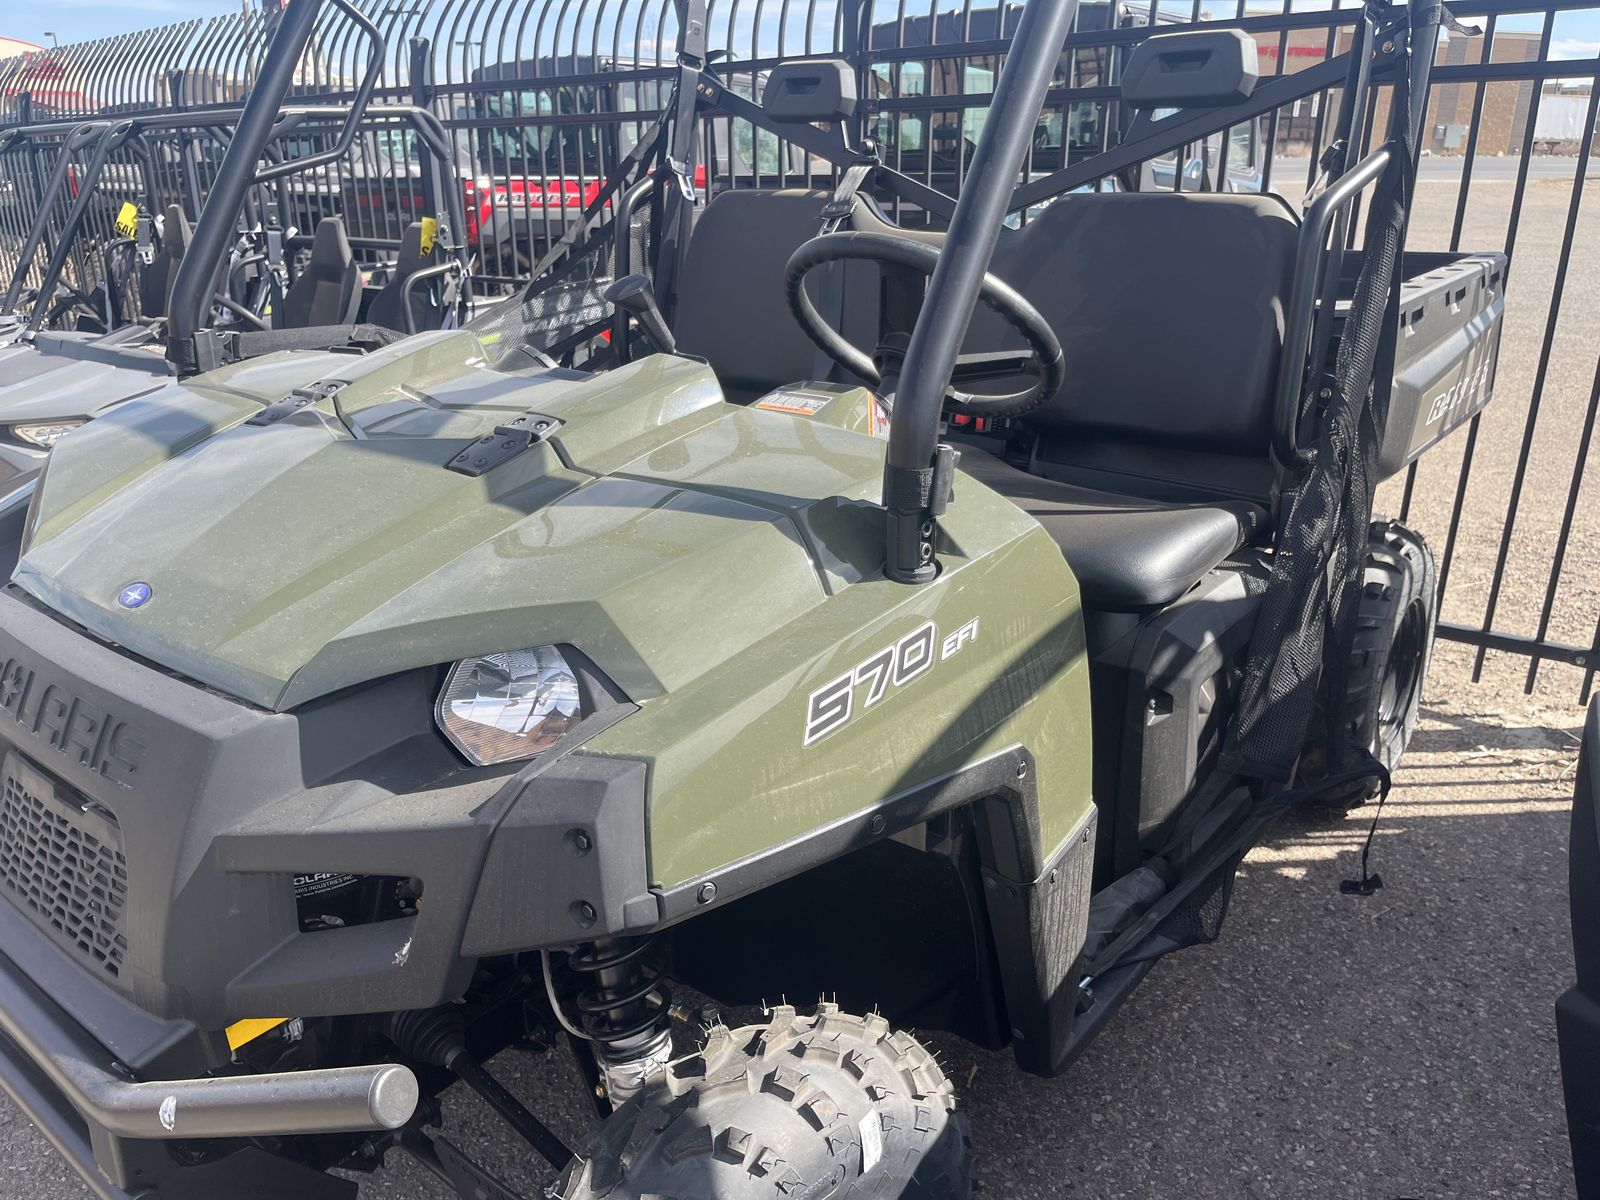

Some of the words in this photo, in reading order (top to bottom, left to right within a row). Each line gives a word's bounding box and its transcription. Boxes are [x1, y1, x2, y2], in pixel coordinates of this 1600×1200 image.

[0, 656, 147, 790] OLARIS
[803, 621, 936, 747] 570
[940, 616, 980, 662] EFI
